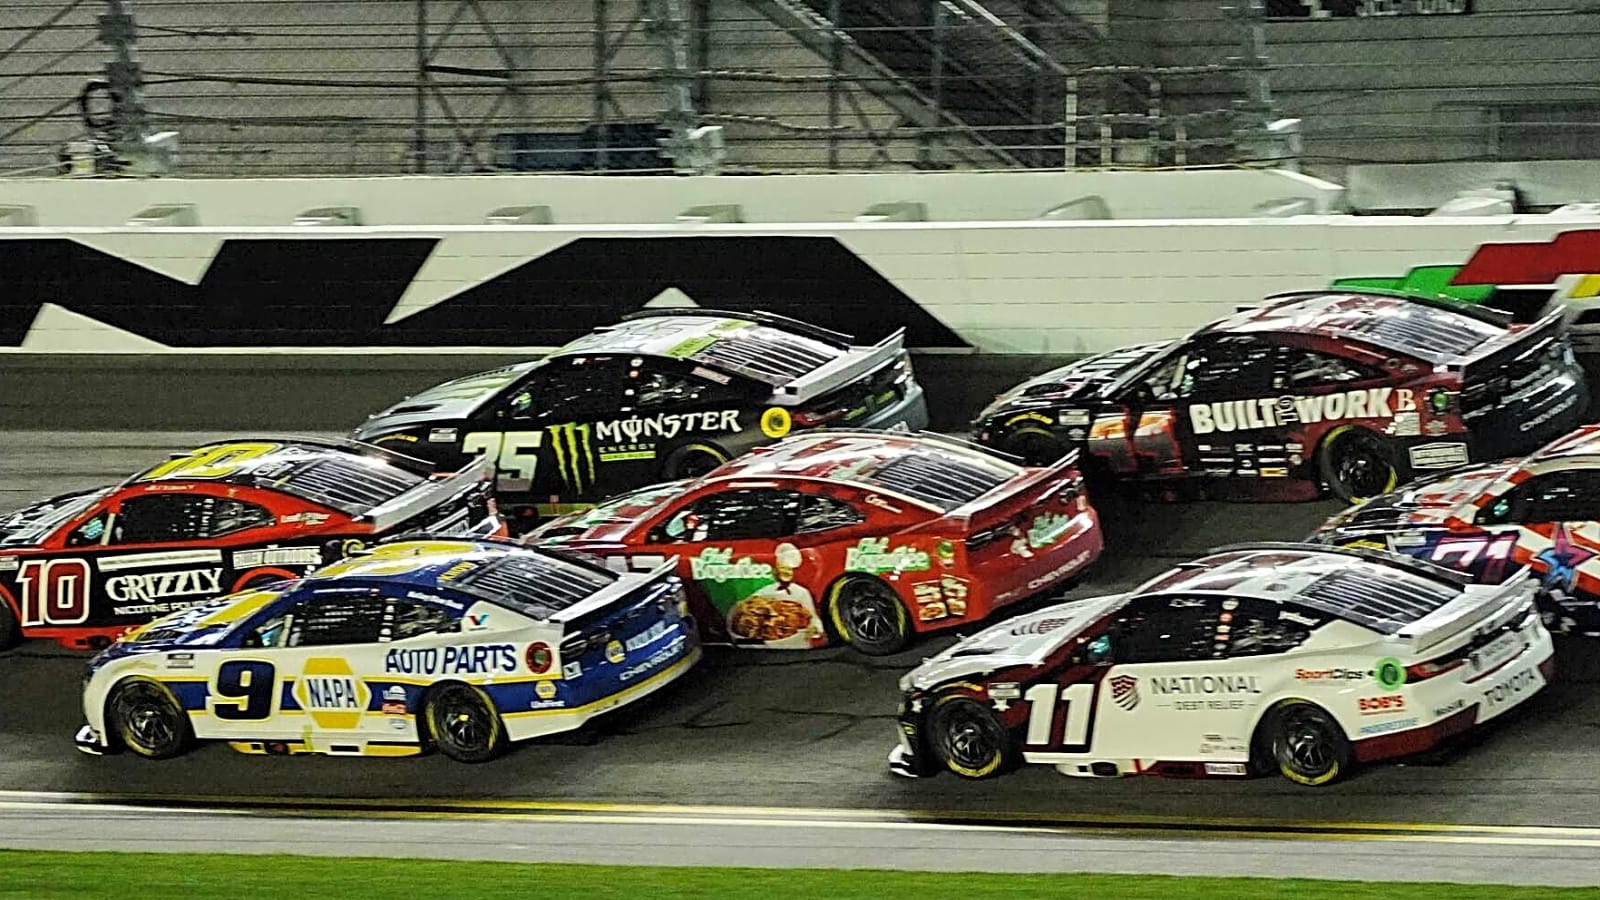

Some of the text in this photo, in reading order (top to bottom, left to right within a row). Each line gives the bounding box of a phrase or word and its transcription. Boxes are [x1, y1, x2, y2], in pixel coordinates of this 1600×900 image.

[1189, 398, 1277, 434] BUILT
[1295, 387, 1393, 424] WORK
[15, 558, 91, 627] 10
[105, 568, 224, 602] GRIZZLY
[386, 645, 517, 675] AUTO PARTS
[214, 660, 275, 720] 9
[307, 678, 359, 708] NAPA
[1150, 675, 1262, 695] NATIONAL
[1483, 667, 1536, 707] TOYOTA
[1024, 683, 1096, 746] 11
